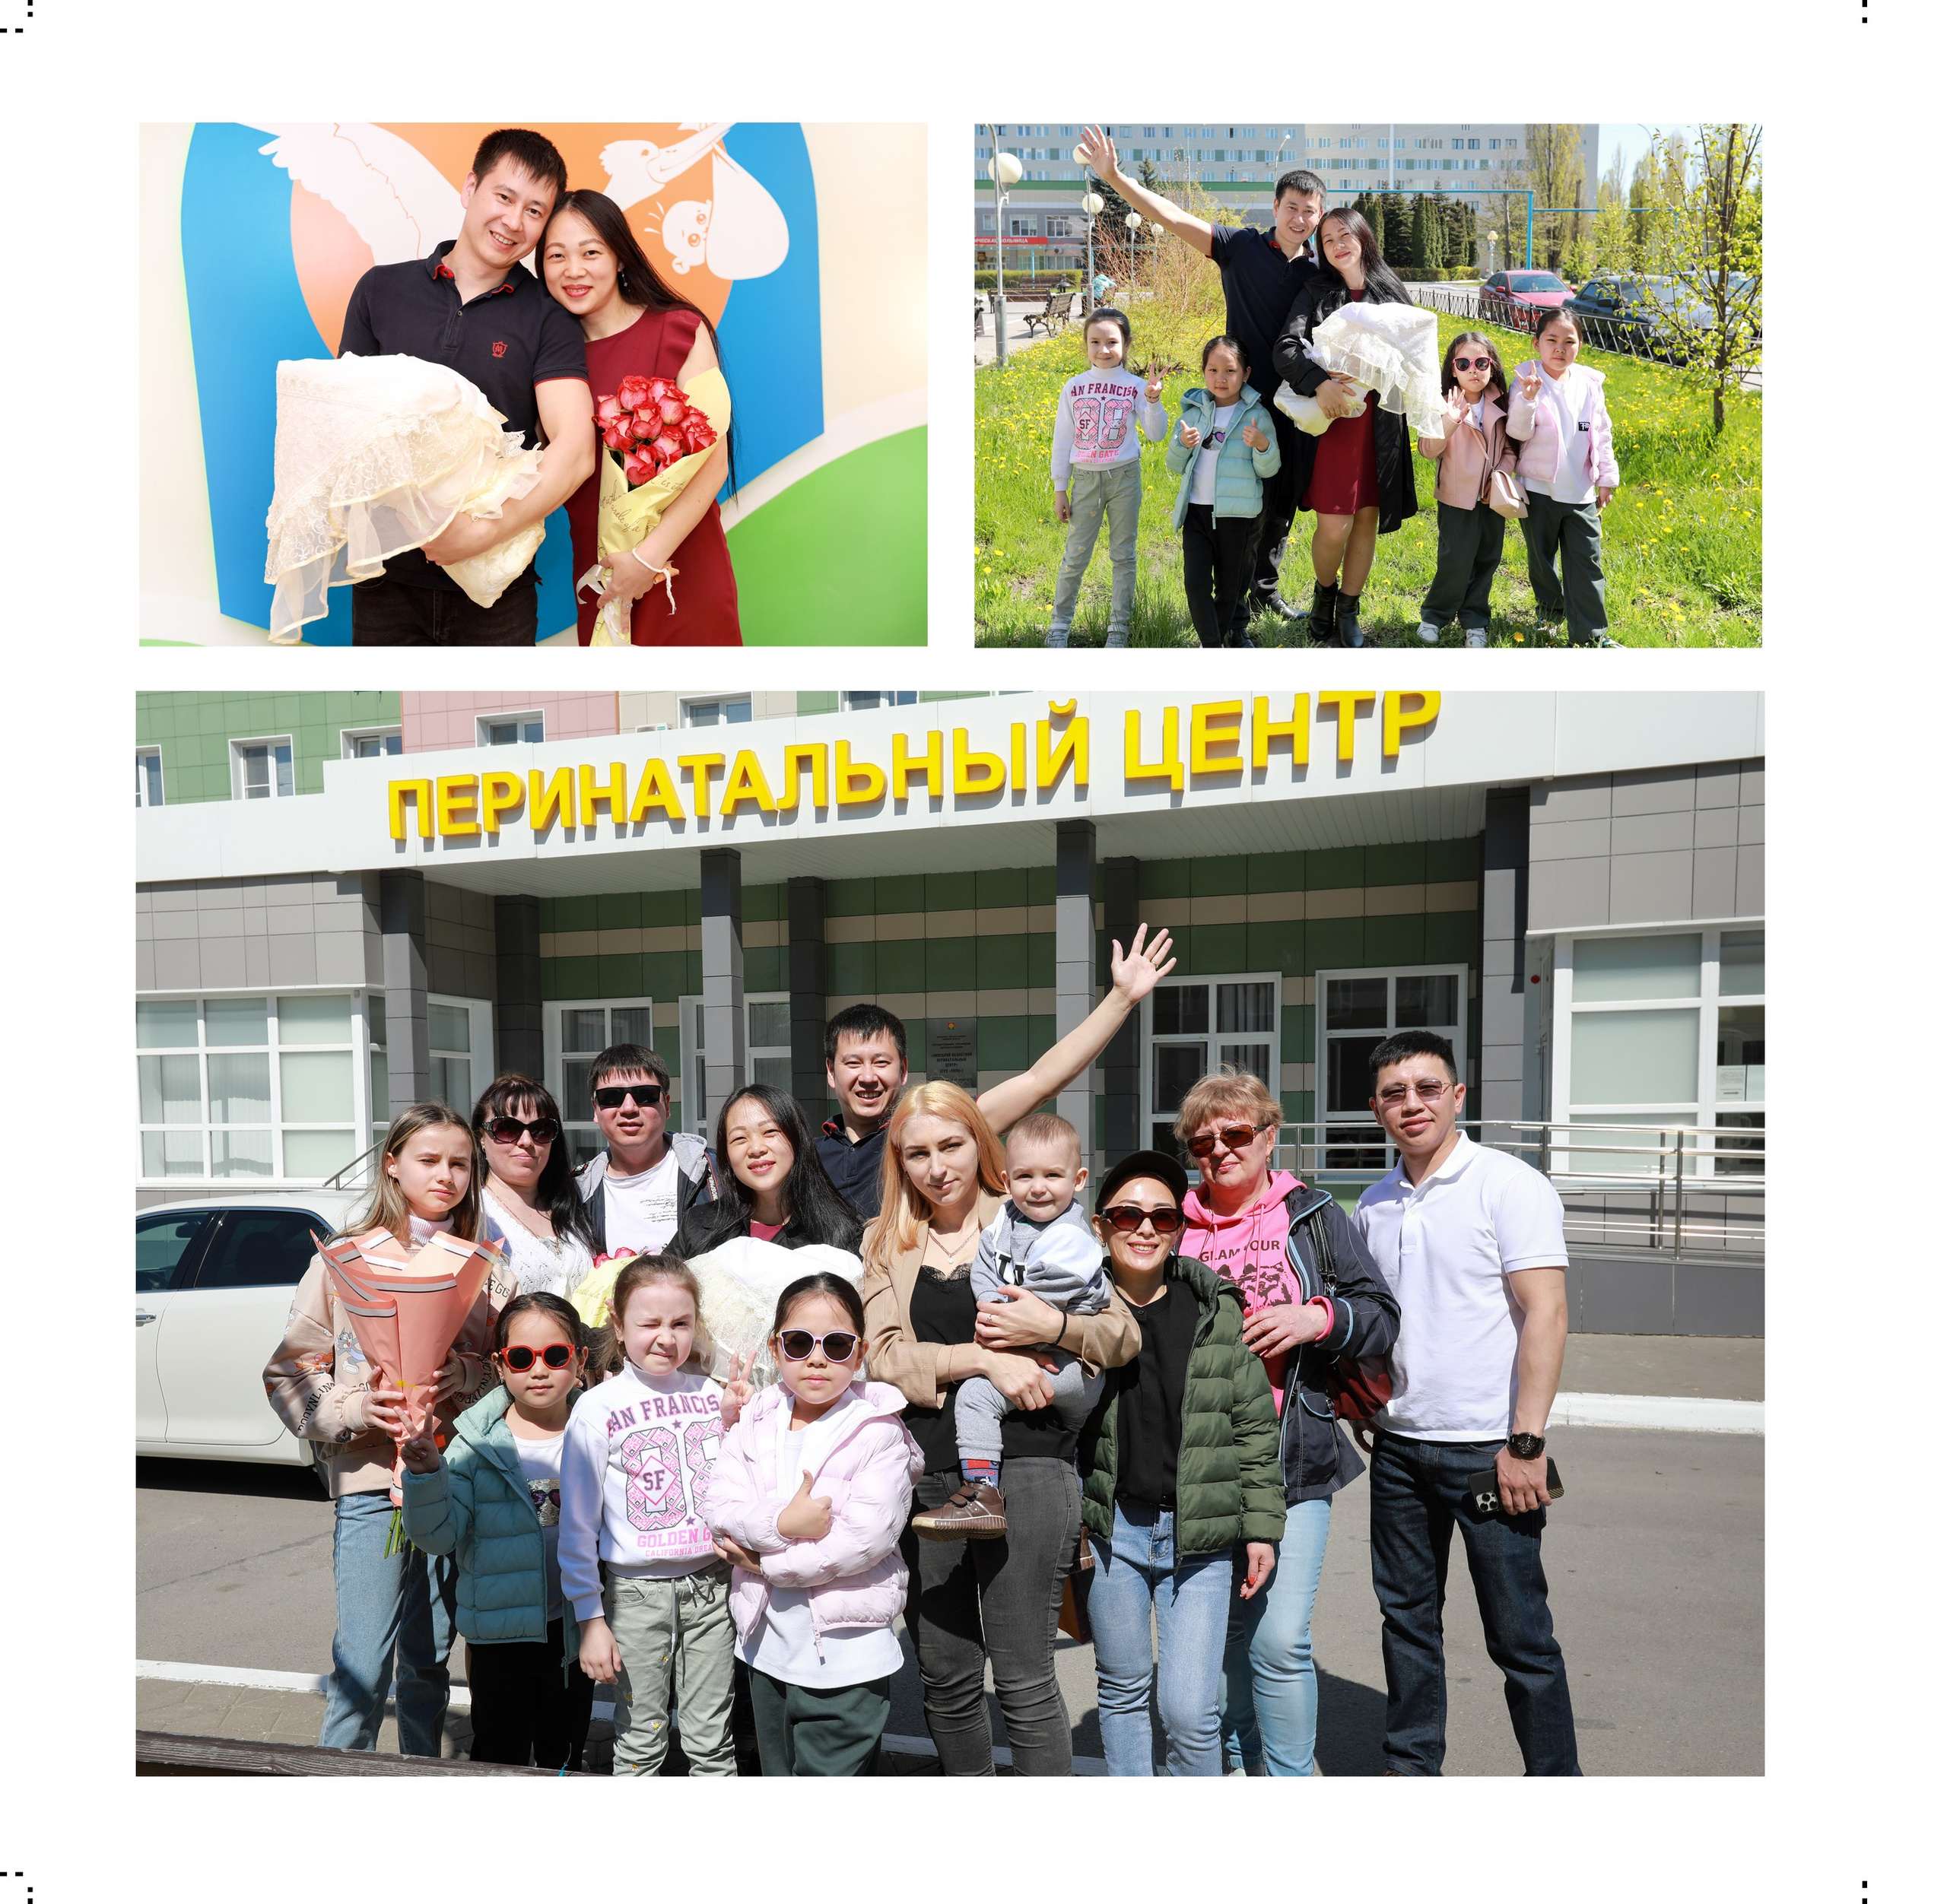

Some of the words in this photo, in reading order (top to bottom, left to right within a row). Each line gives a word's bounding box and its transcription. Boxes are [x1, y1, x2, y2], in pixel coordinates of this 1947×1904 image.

[1071, 385, 1085, 397] AN
[1079, 419, 1091, 430] SF
[389, 698, 1089, 839] ПЕРИНАТАЛЬНЫЙ
[1124, 691, 1440, 791] ЦЕНТР
[640, 1393, 720, 1421] FRANCIS
[642, 1469, 665, 1491] SF
[637, 1528, 699, 1548] GOLDEN
[703, 1526, 713, 1541] G
[645, 1546, 693, 1557] CALIFORNIA
[694, 1543, 713, 1554] DREA
